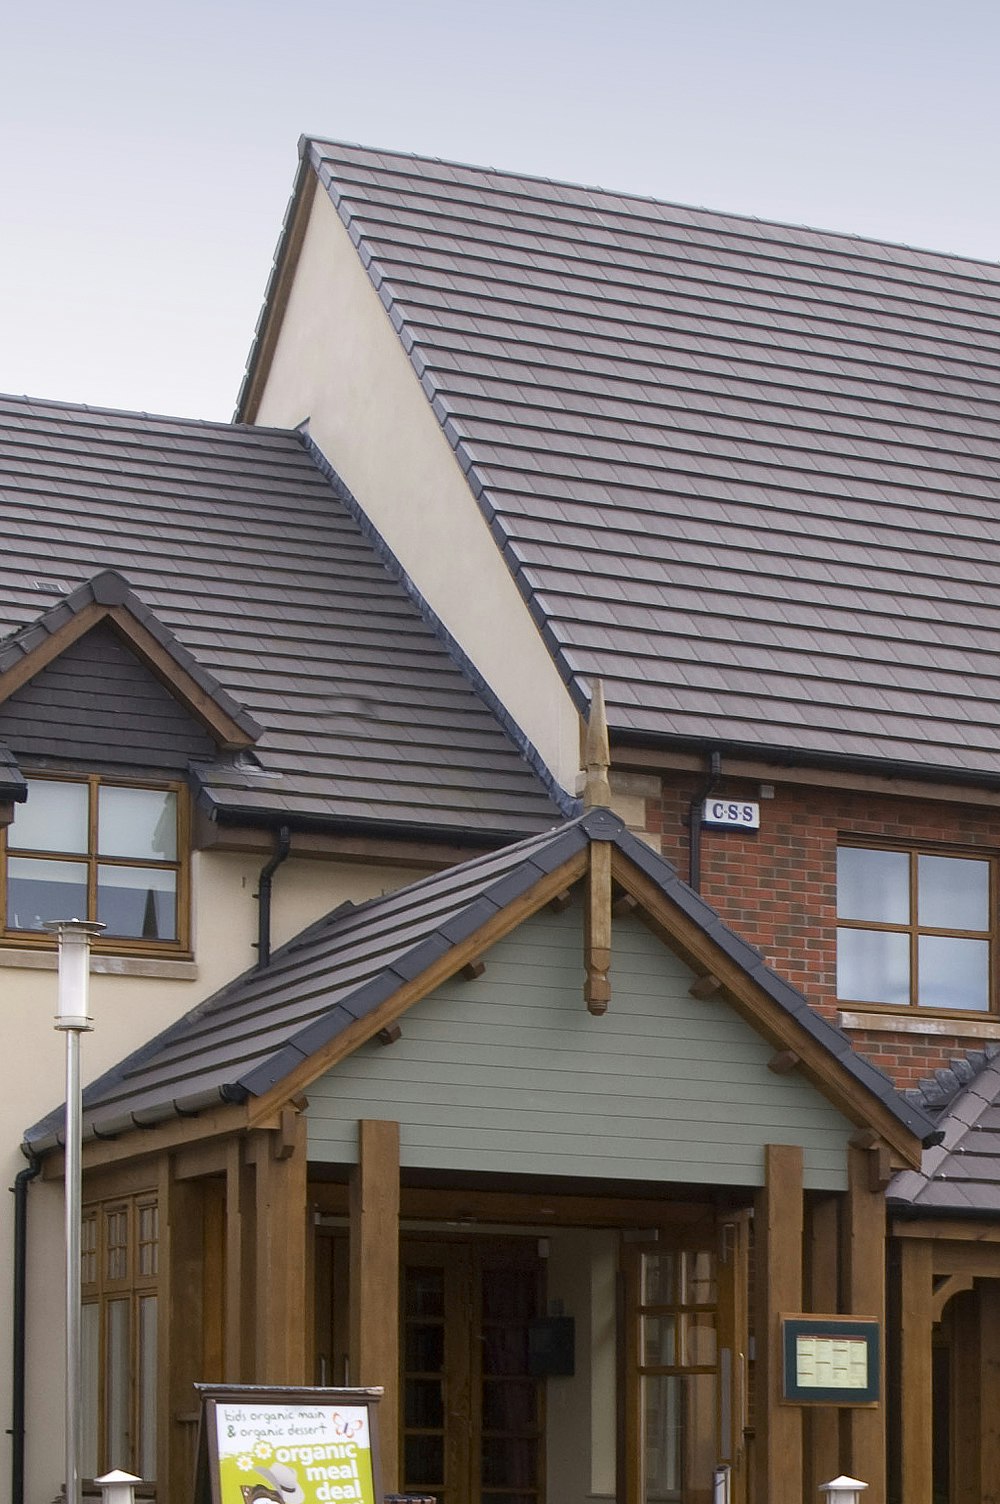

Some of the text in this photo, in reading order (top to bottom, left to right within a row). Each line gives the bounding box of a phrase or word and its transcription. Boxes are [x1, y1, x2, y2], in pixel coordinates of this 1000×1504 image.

[224, 1408, 326, 1424] kids organic main
[227, 1423, 328, 1440] & organic dessert
[275, 1443, 357, 1466] organic
[306, 1459, 359, 1481] meal
[316, 1479, 362, 1501] deal
